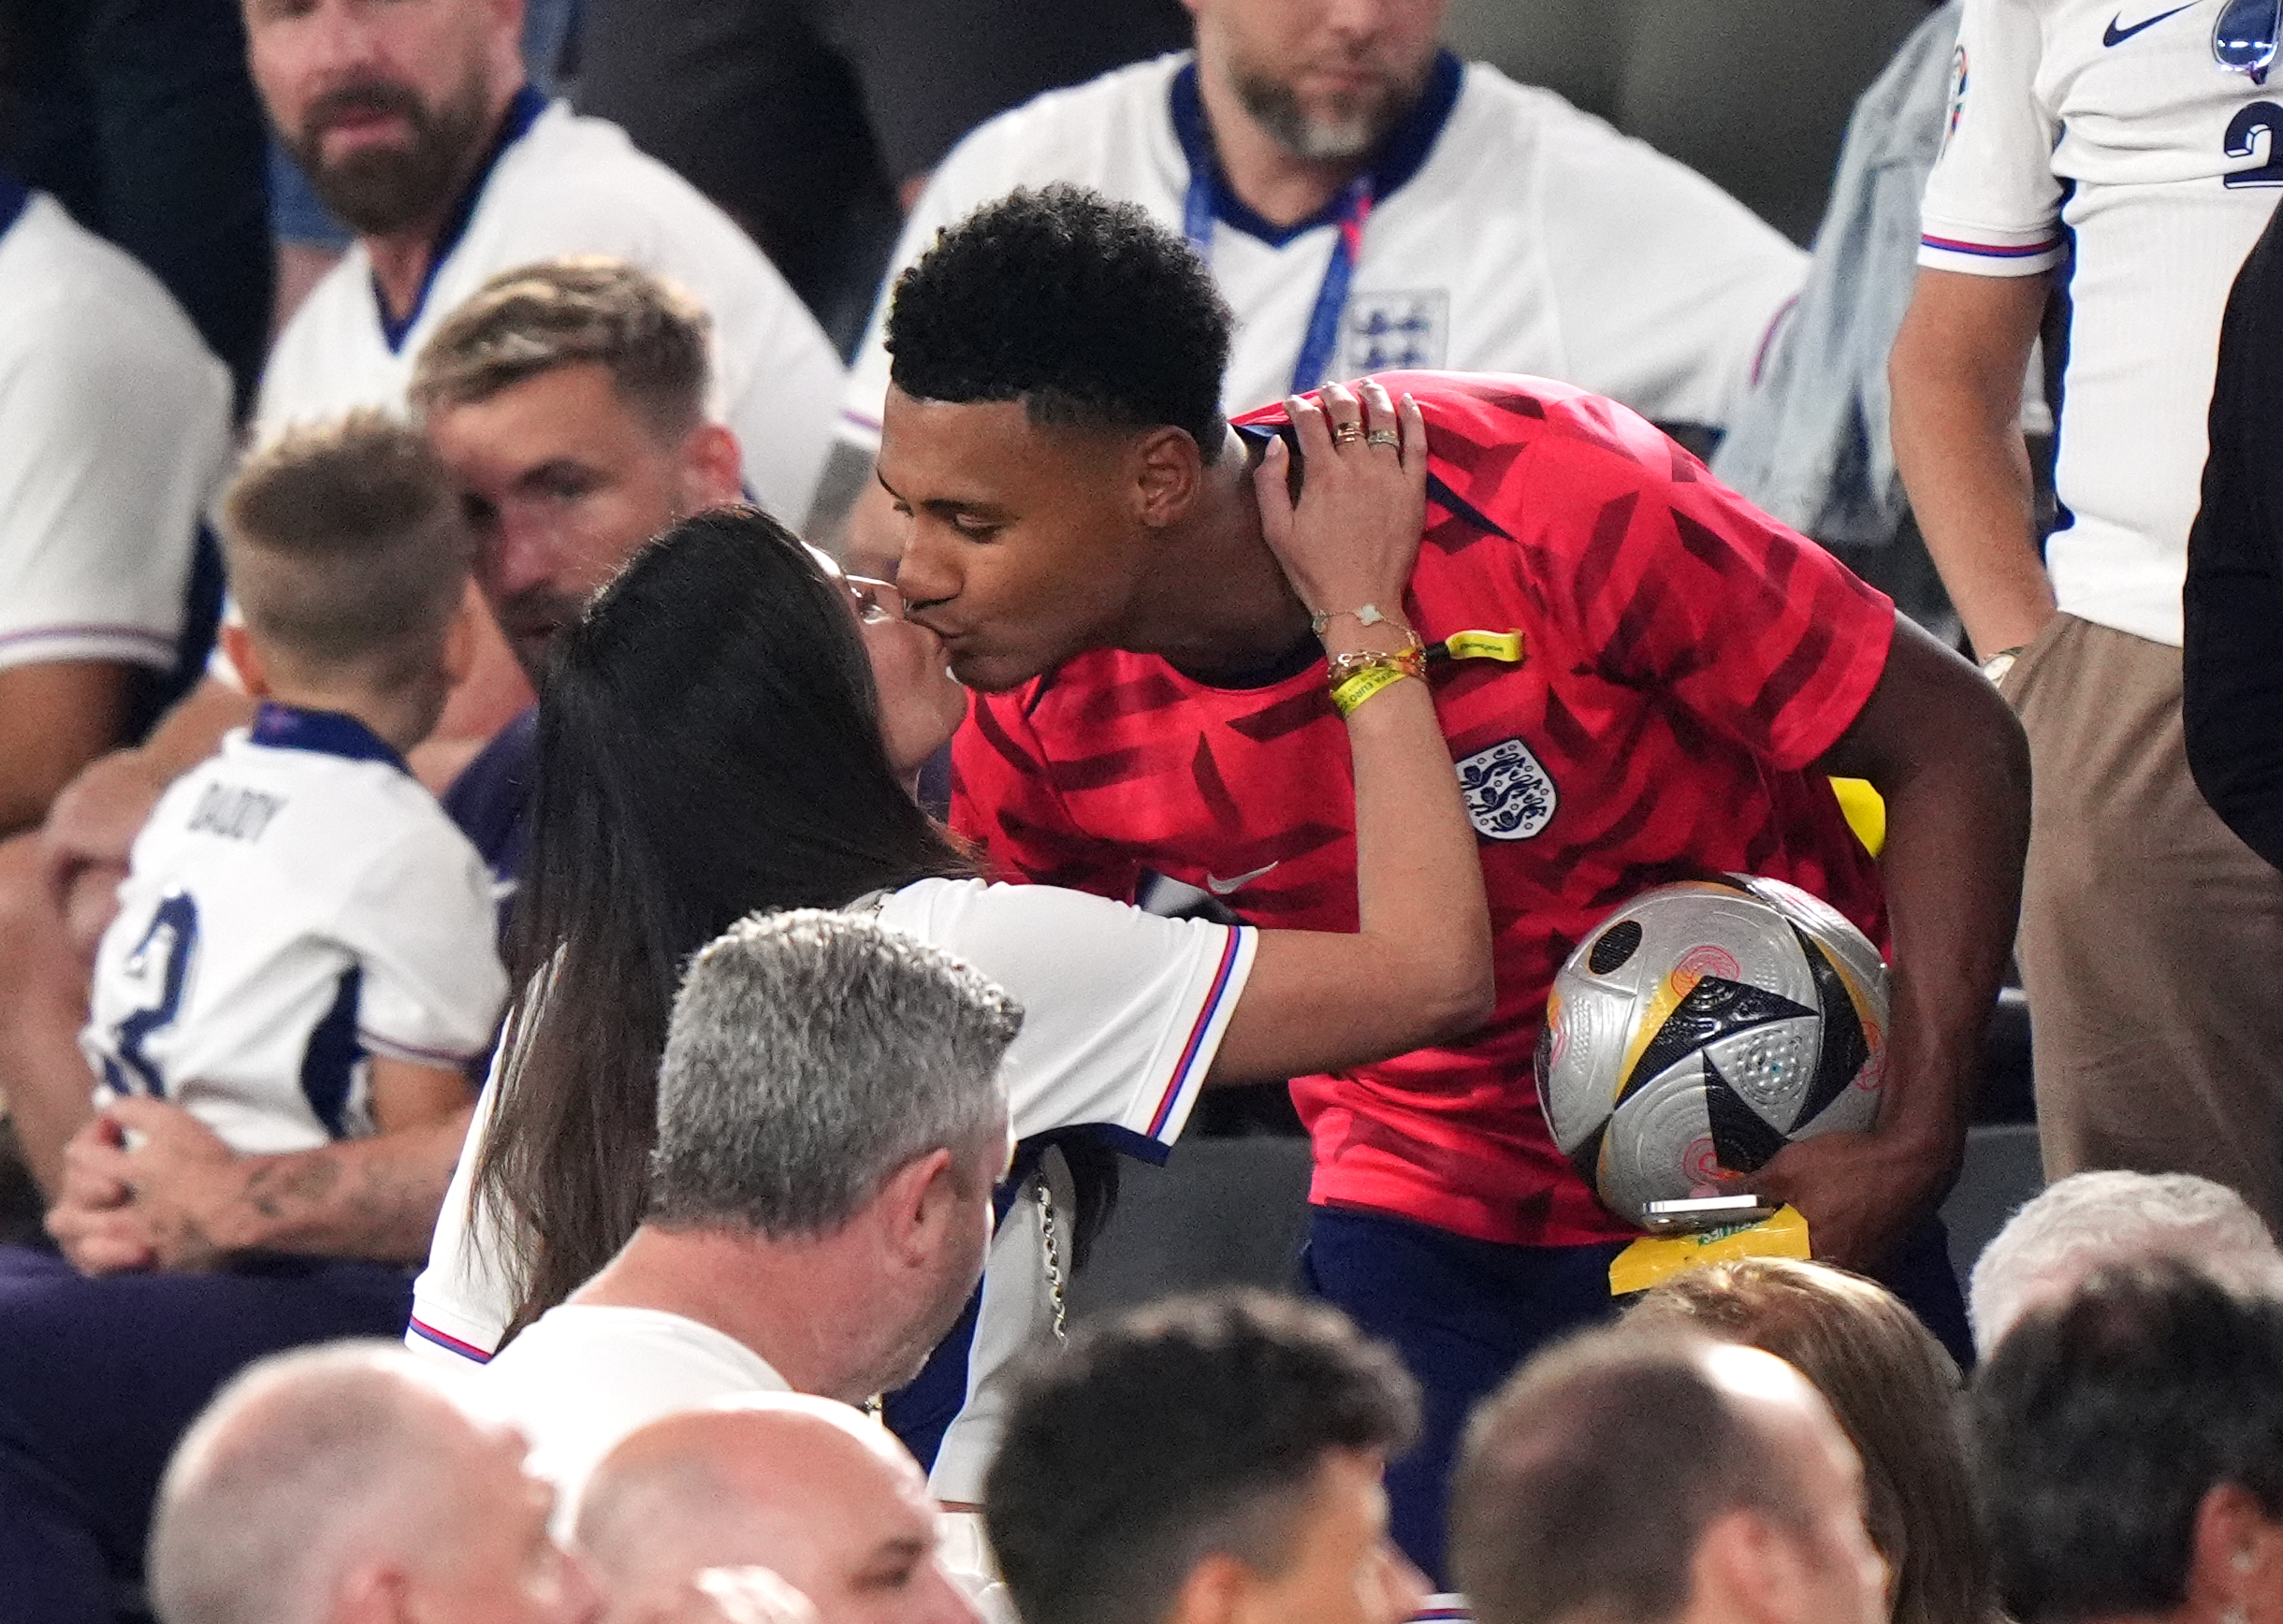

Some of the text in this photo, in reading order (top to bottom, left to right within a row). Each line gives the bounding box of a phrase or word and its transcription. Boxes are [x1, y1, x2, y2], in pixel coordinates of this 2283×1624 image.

[2223, 100, 2283, 189] 2
[1349, 681, 1374, 703] EURO
[188, 781, 287, 842] DADDY
